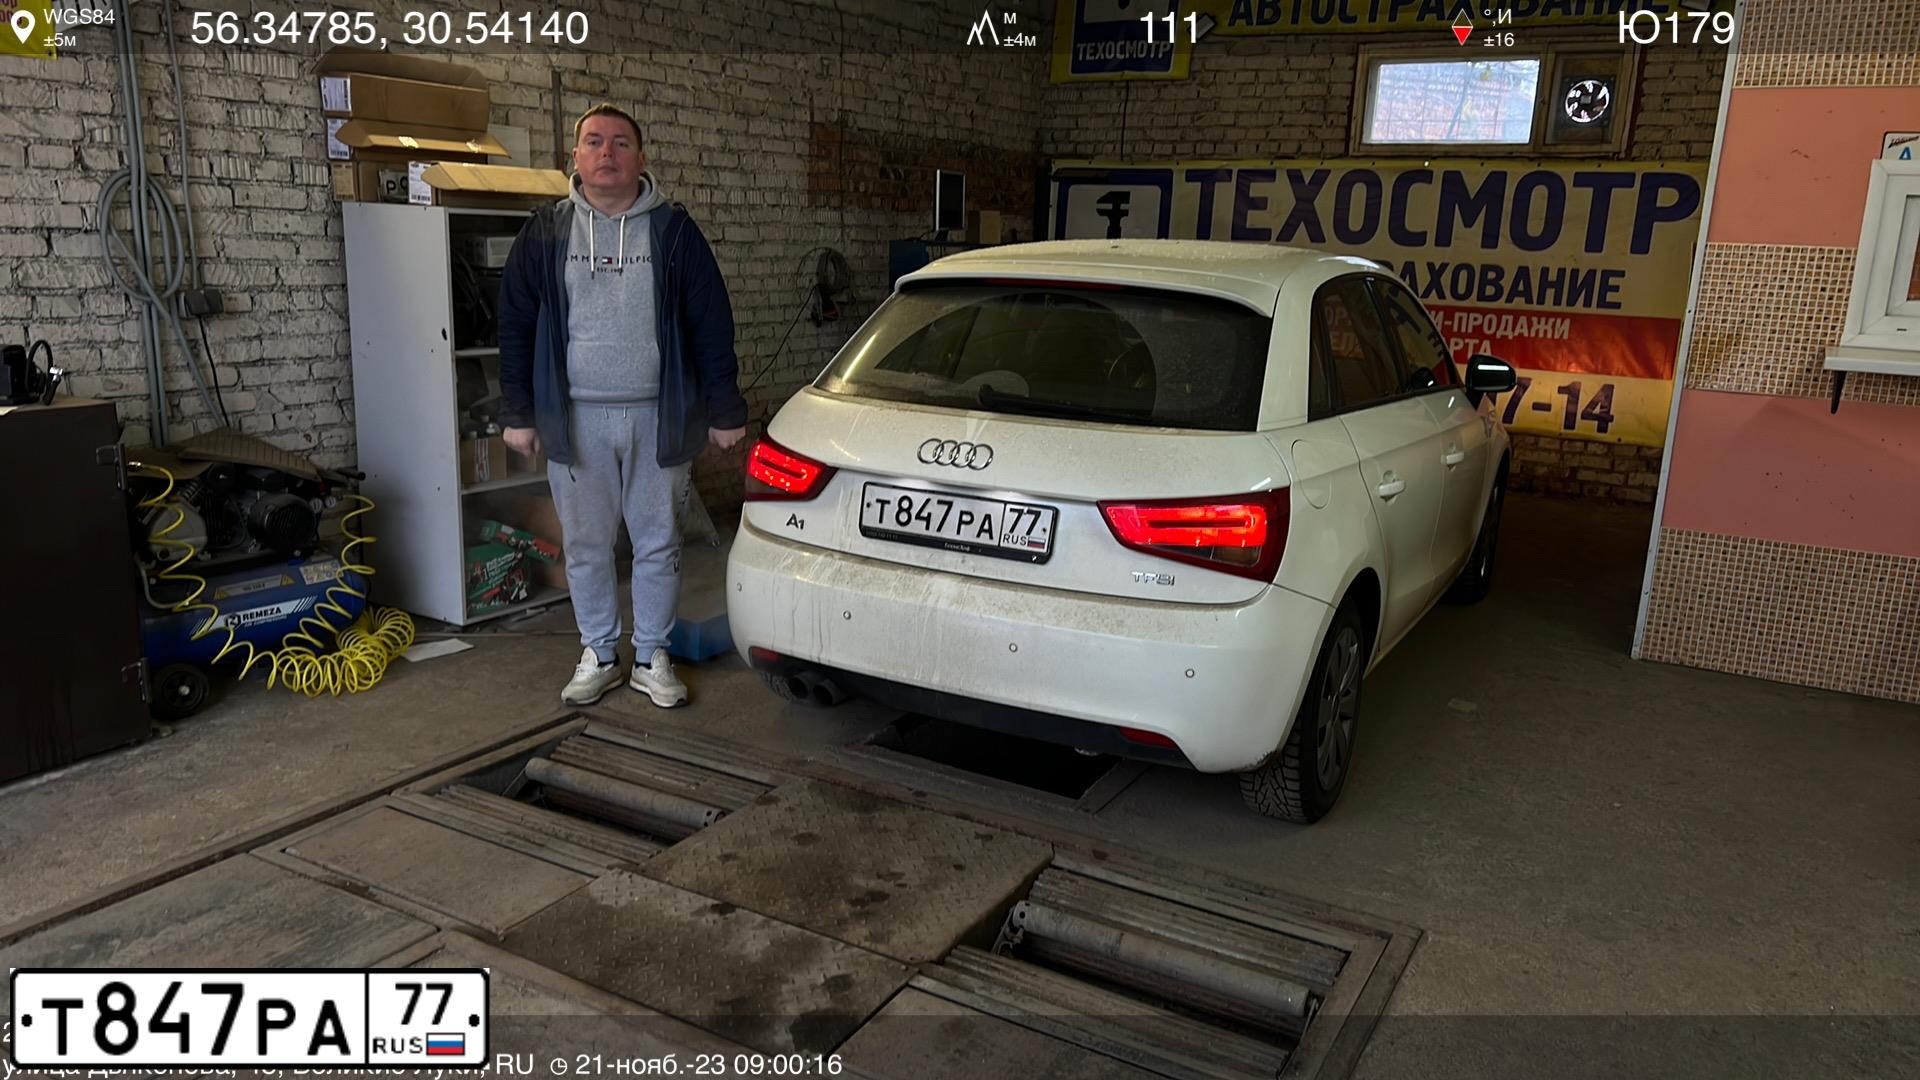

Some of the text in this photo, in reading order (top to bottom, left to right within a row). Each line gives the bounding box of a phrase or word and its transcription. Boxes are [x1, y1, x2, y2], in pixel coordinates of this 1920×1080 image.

[1076, 40, 1171, 61] ТЕХОСМОТР
[1185, 168, 1700, 254] ТЕХОСМОТР
[1487, 377, 1614, 433] 7-14
[786, 513, 805, 530] A1
[875, 495, 1042, 540] Т847РА 77
[1003, 533, 1027, 546] RUS
[243, 606, 282, 621] REMEZA
